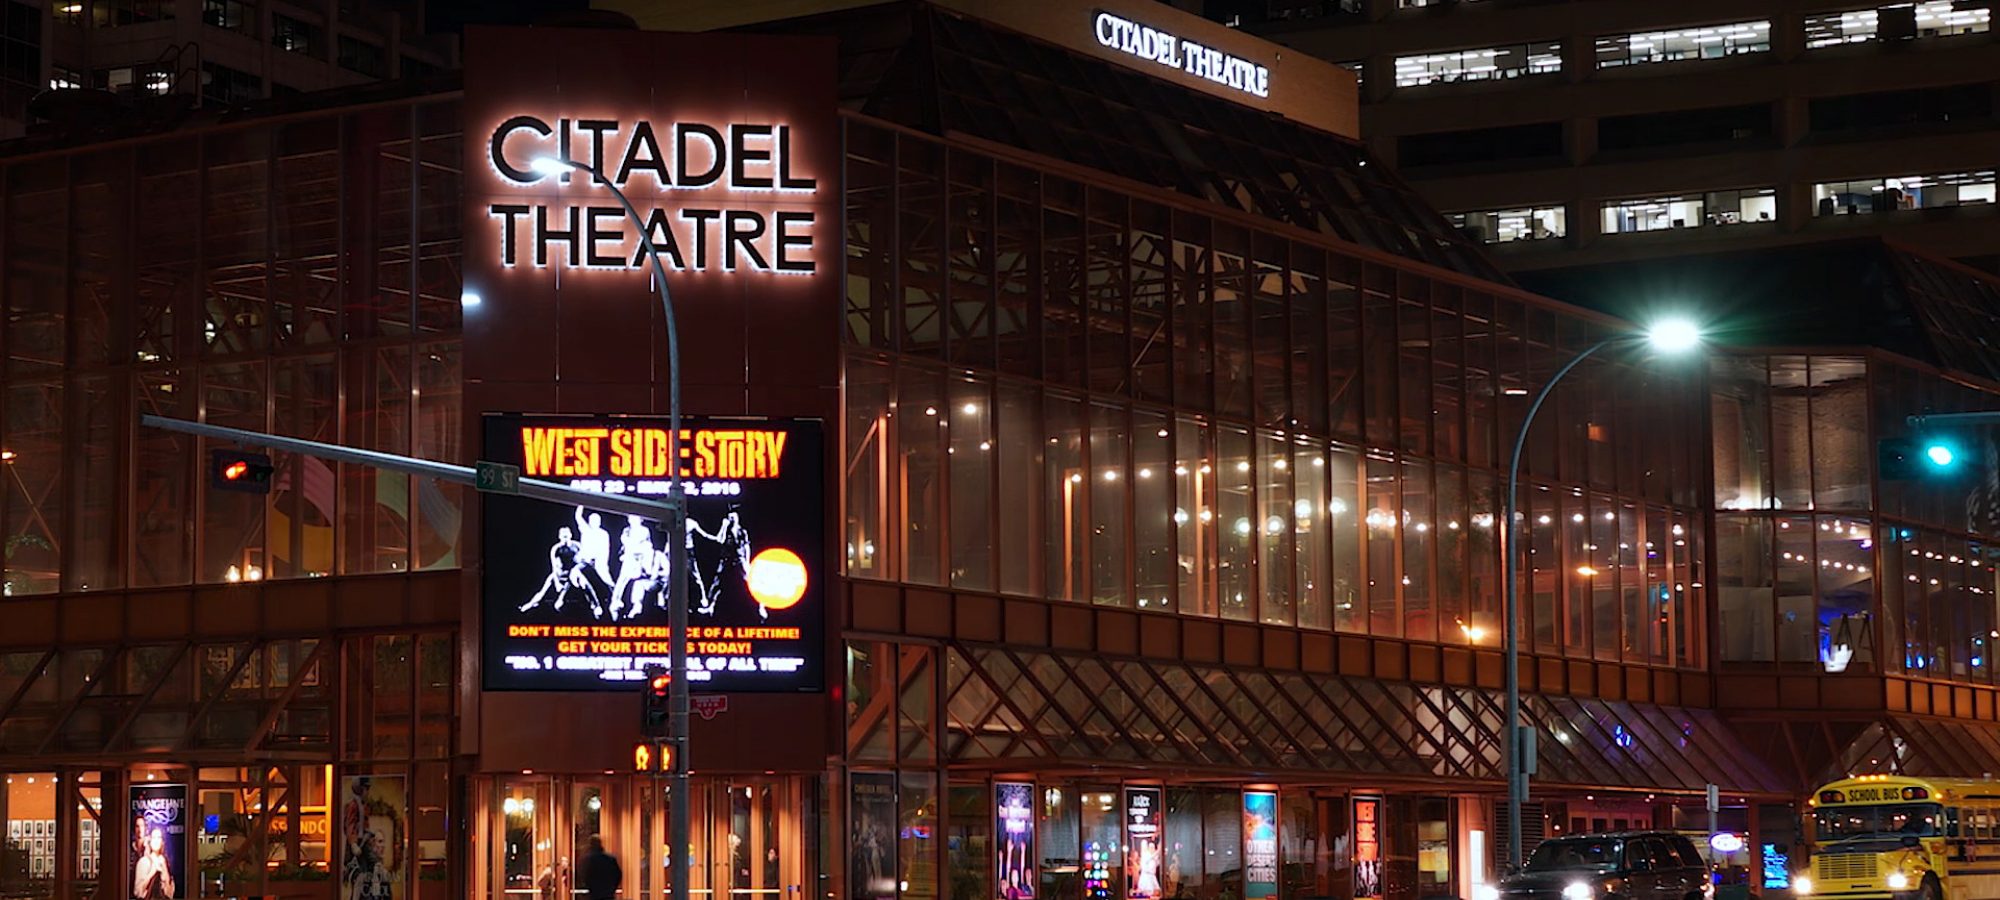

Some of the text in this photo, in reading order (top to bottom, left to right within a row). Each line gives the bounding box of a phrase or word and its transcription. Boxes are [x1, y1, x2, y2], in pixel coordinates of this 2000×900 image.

[1096, 13, 1269, 98] CITADEL THEATRE
[488, 115, 817, 192] CITADEL
[488, 204, 817, 274] THEATRE
[522, 427, 787, 478] WEST SIDE STORY
[481, 468, 514, 488] 99 ST
[509, 625, 800, 640] DON'T MISS THE EXPERICE OF A LIFETIME!
[558, 641, 751, 655] GET YOUR TICKS TODAY!
[1849, 788, 1899, 802] SCHOOL BUS
[1247, 840, 1275, 853] OTHER
[1247, 855, 1275, 867] DESERT
[1248, 868, 1275, 882] CITIES
